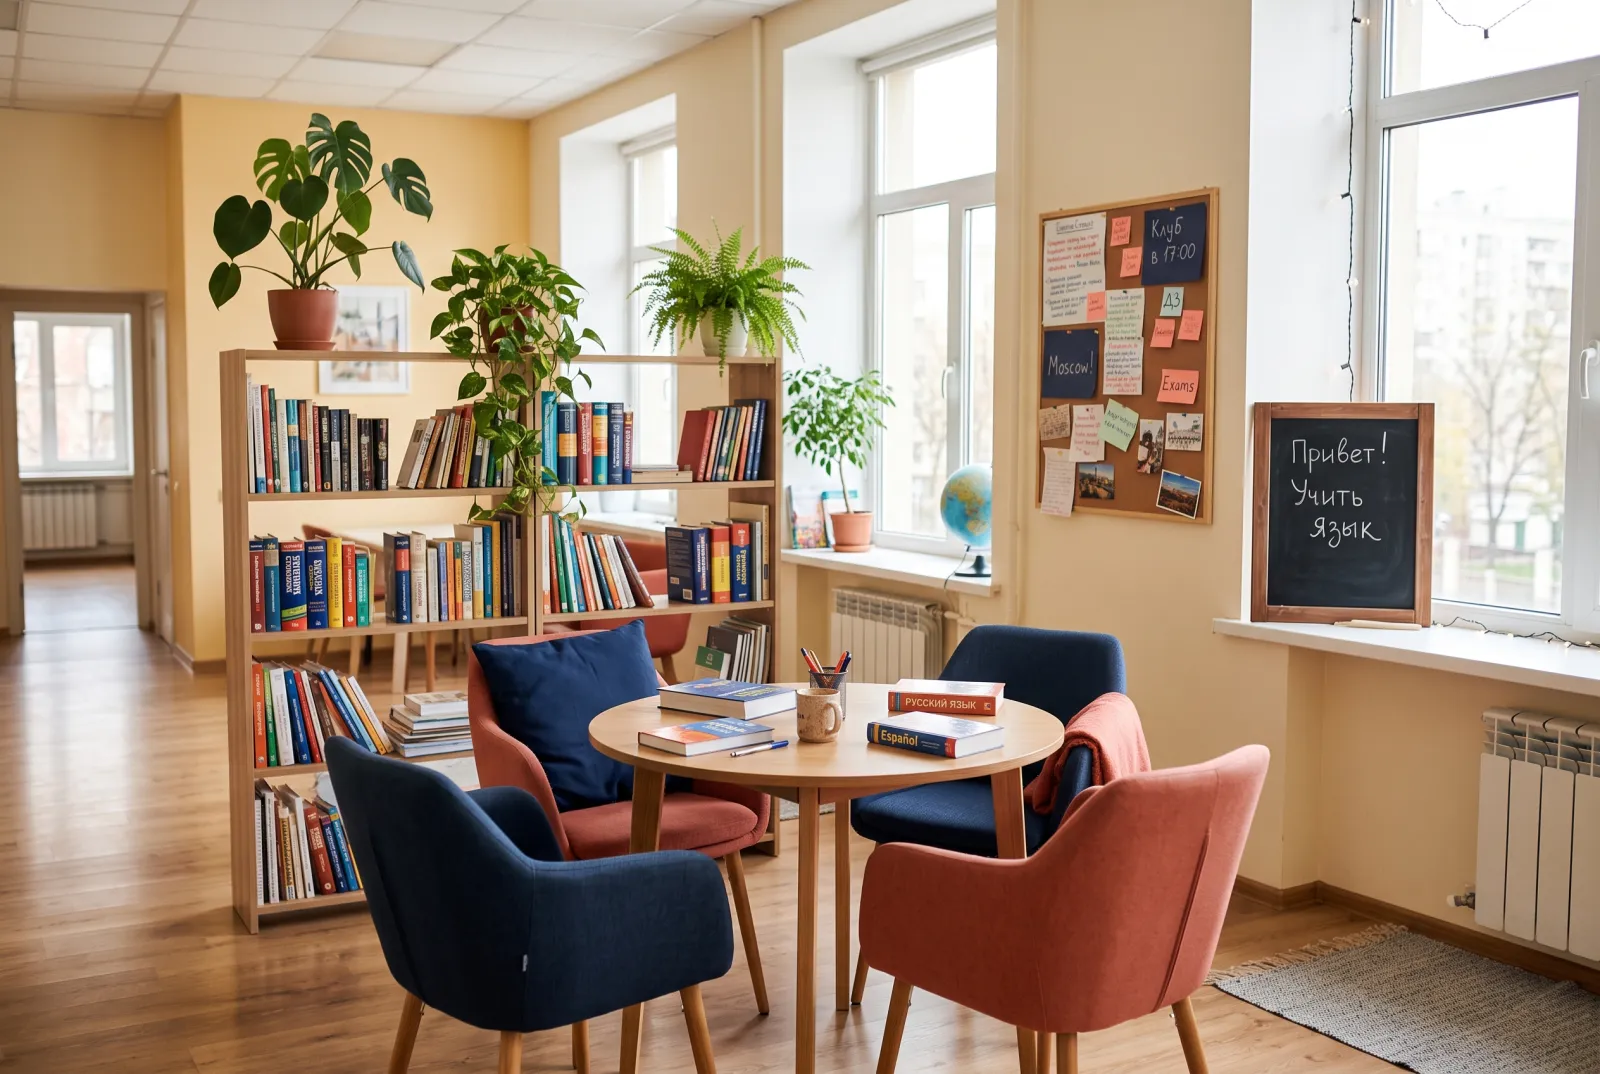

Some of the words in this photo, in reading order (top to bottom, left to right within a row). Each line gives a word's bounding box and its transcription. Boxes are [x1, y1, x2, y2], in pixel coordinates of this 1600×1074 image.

[1151, 216, 1183, 242] Клуб
[1164, 243, 1196, 262] 17:00
[1163, 292, 1180, 310] ДЗ
[1048, 351, 1094, 376] Moscow!
[1162, 376, 1194, 392] Exams
[1291, 479, 1363, 507] Учить
[905, 697, 947, 709] РУССКИЙ
[949, 700, 976, 709] ЯЗЫК
[881, 729, 918, 746] Español
